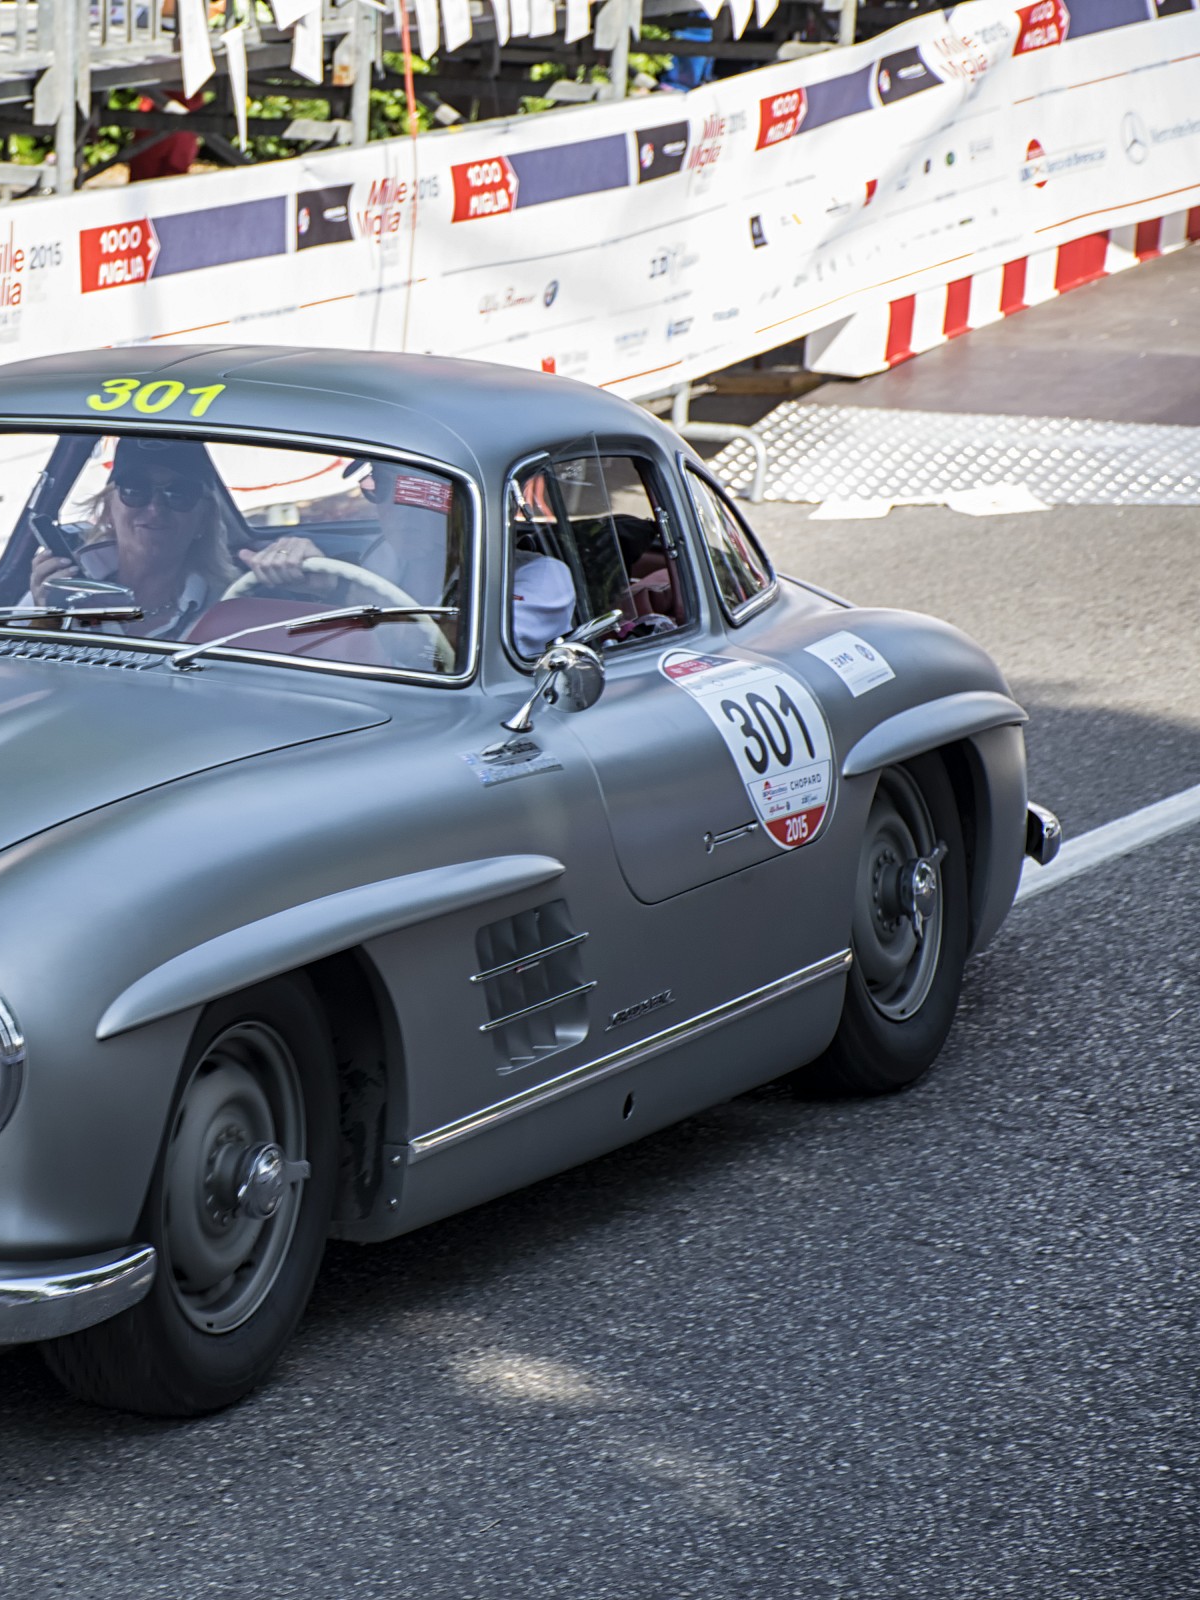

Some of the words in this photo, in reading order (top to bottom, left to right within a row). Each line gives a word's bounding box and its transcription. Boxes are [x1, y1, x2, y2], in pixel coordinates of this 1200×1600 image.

[99, 226, 143, 253] 1000
[29, 241, 63, 270] 2015
[98, 256, 144, 286] MIGLIA
[86, 378, 226, 417] 301
[721, 685, 815, 775] 301
[785, 814, 809, 844] 2015
